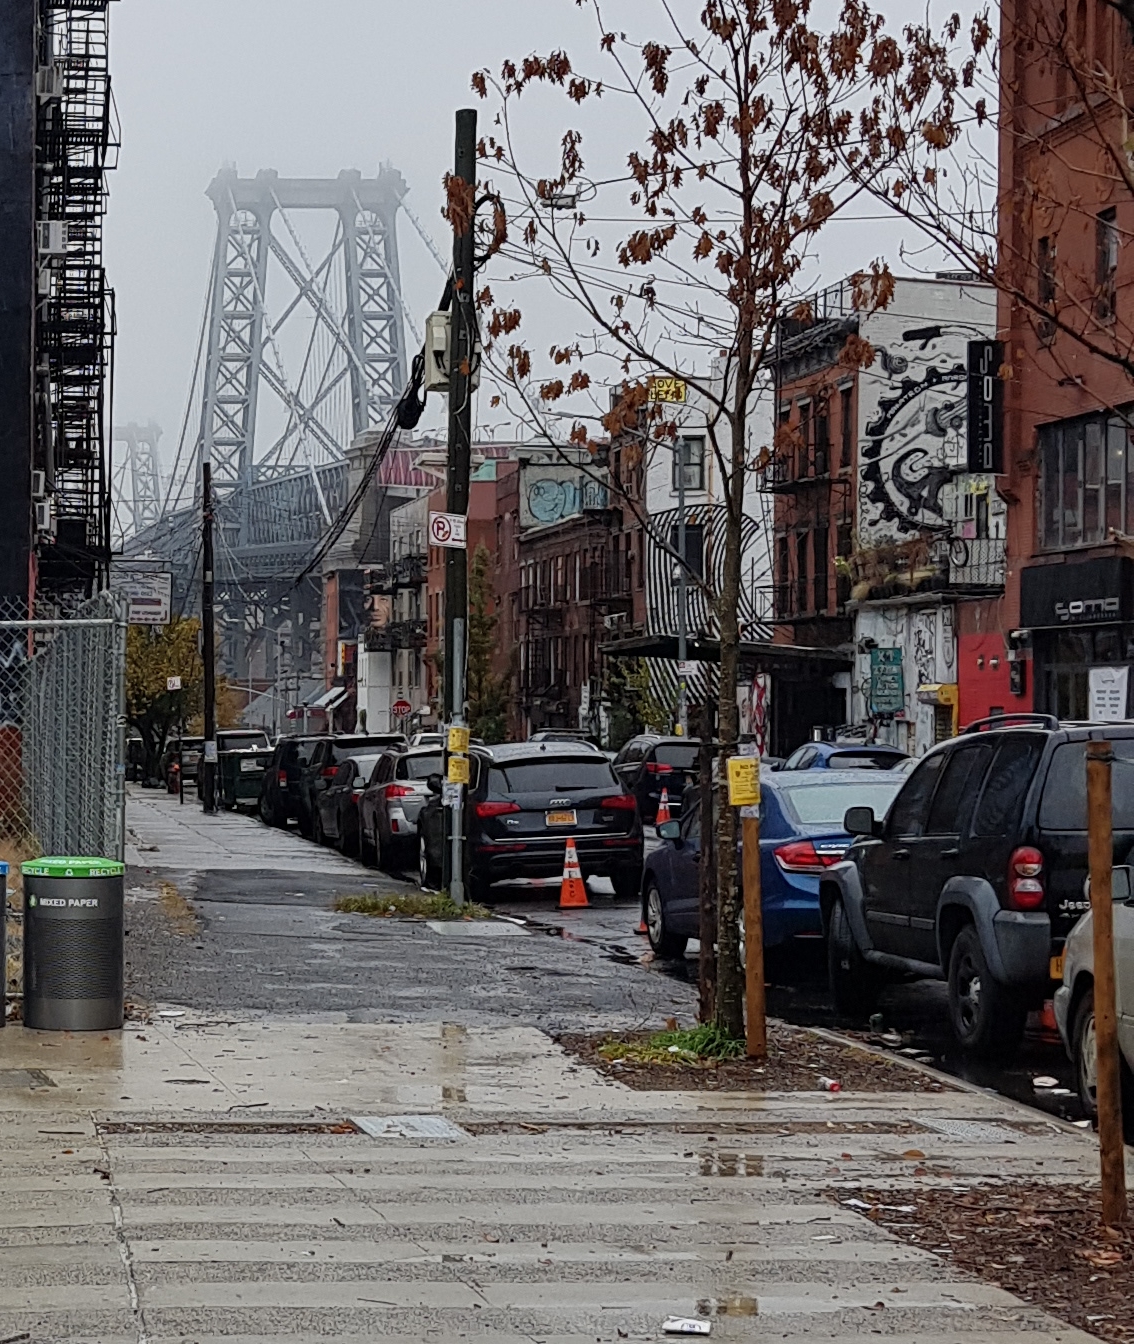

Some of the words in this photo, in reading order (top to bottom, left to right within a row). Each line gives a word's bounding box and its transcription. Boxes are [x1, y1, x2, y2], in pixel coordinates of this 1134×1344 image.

[392, 706, 411, 714] STOP
[39, 897, 66, 906] MIXED
[68, 898, 98, 907] PAPER
